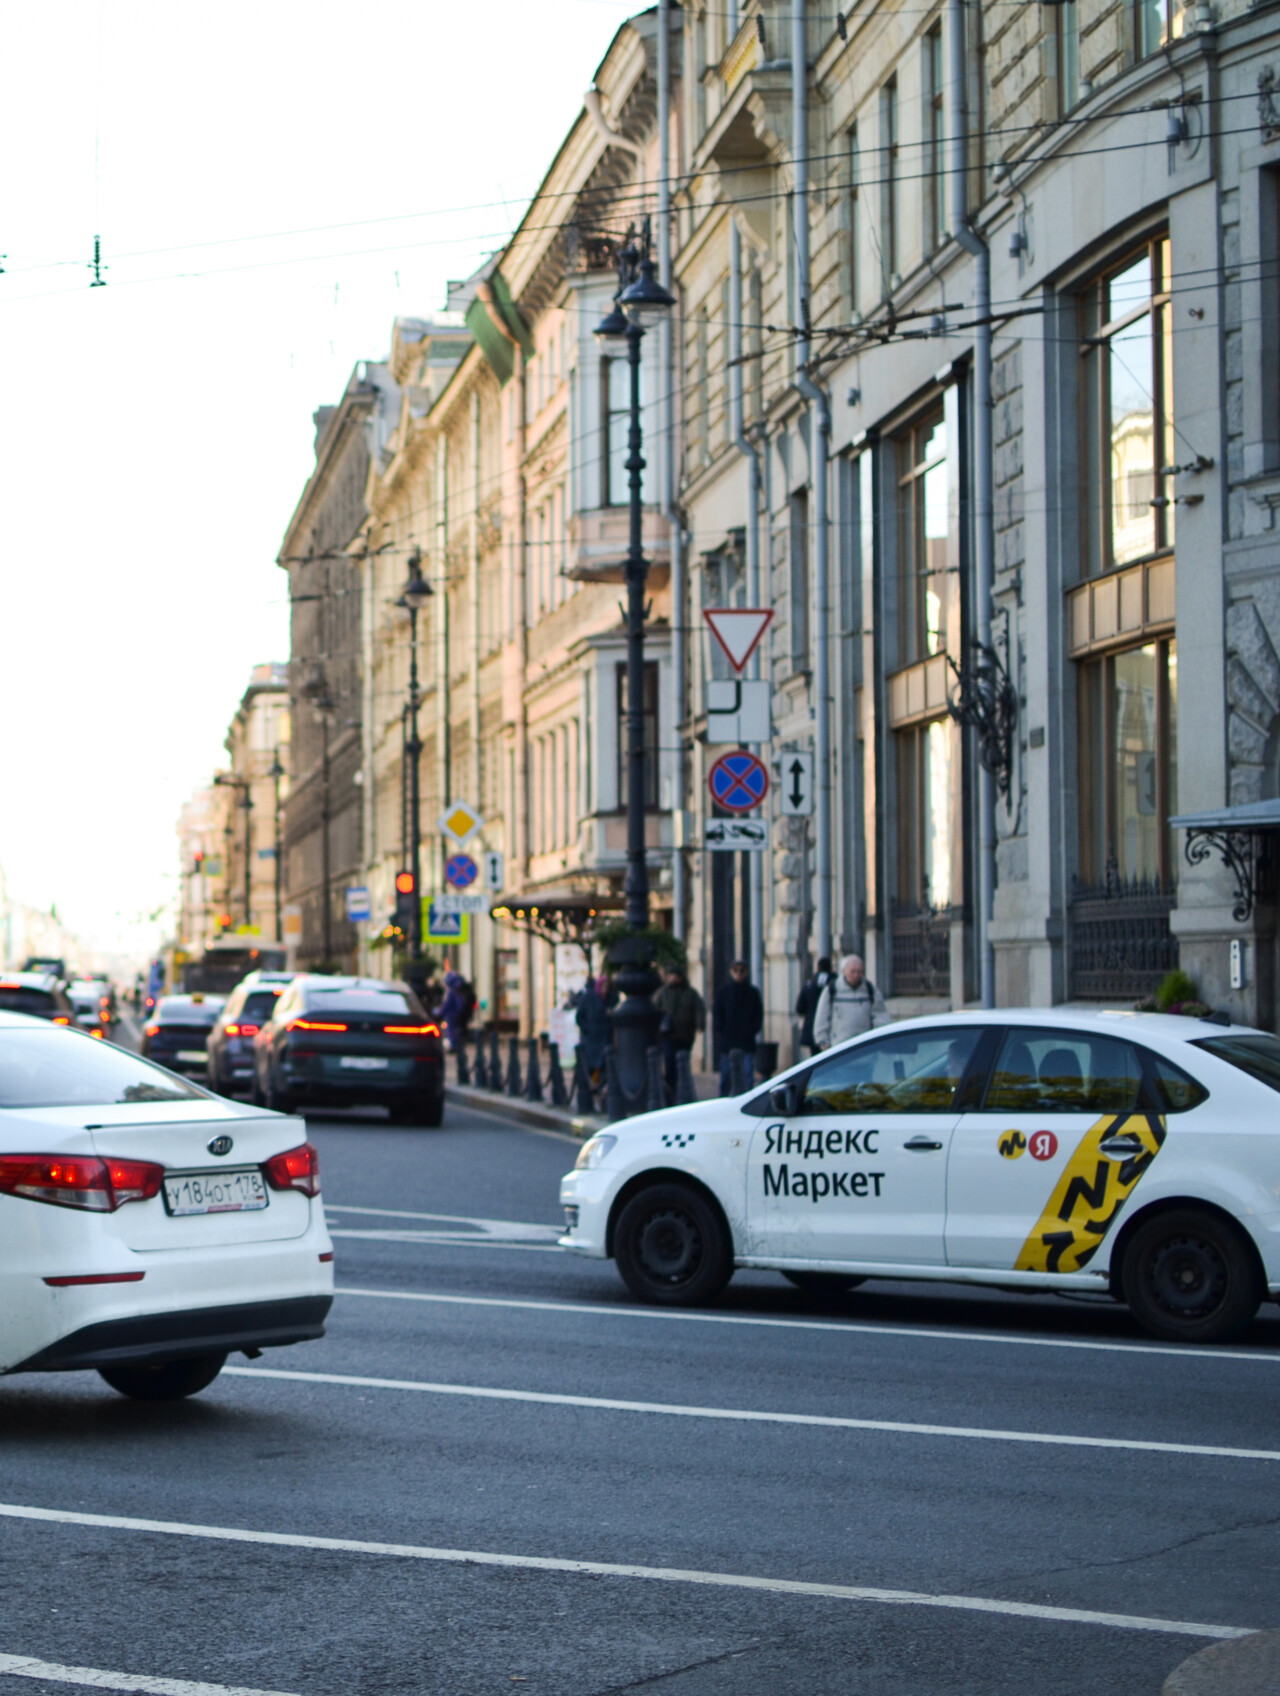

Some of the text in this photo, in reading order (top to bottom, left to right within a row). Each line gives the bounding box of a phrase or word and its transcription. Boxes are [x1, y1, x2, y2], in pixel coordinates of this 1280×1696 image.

[441, 896, 483, 910] СТОП
[764, 1123, 880, 1159] Яндекс
[235, 1175, 261, 1194] 178
[763, 1163, 886, 1203] Маркет
